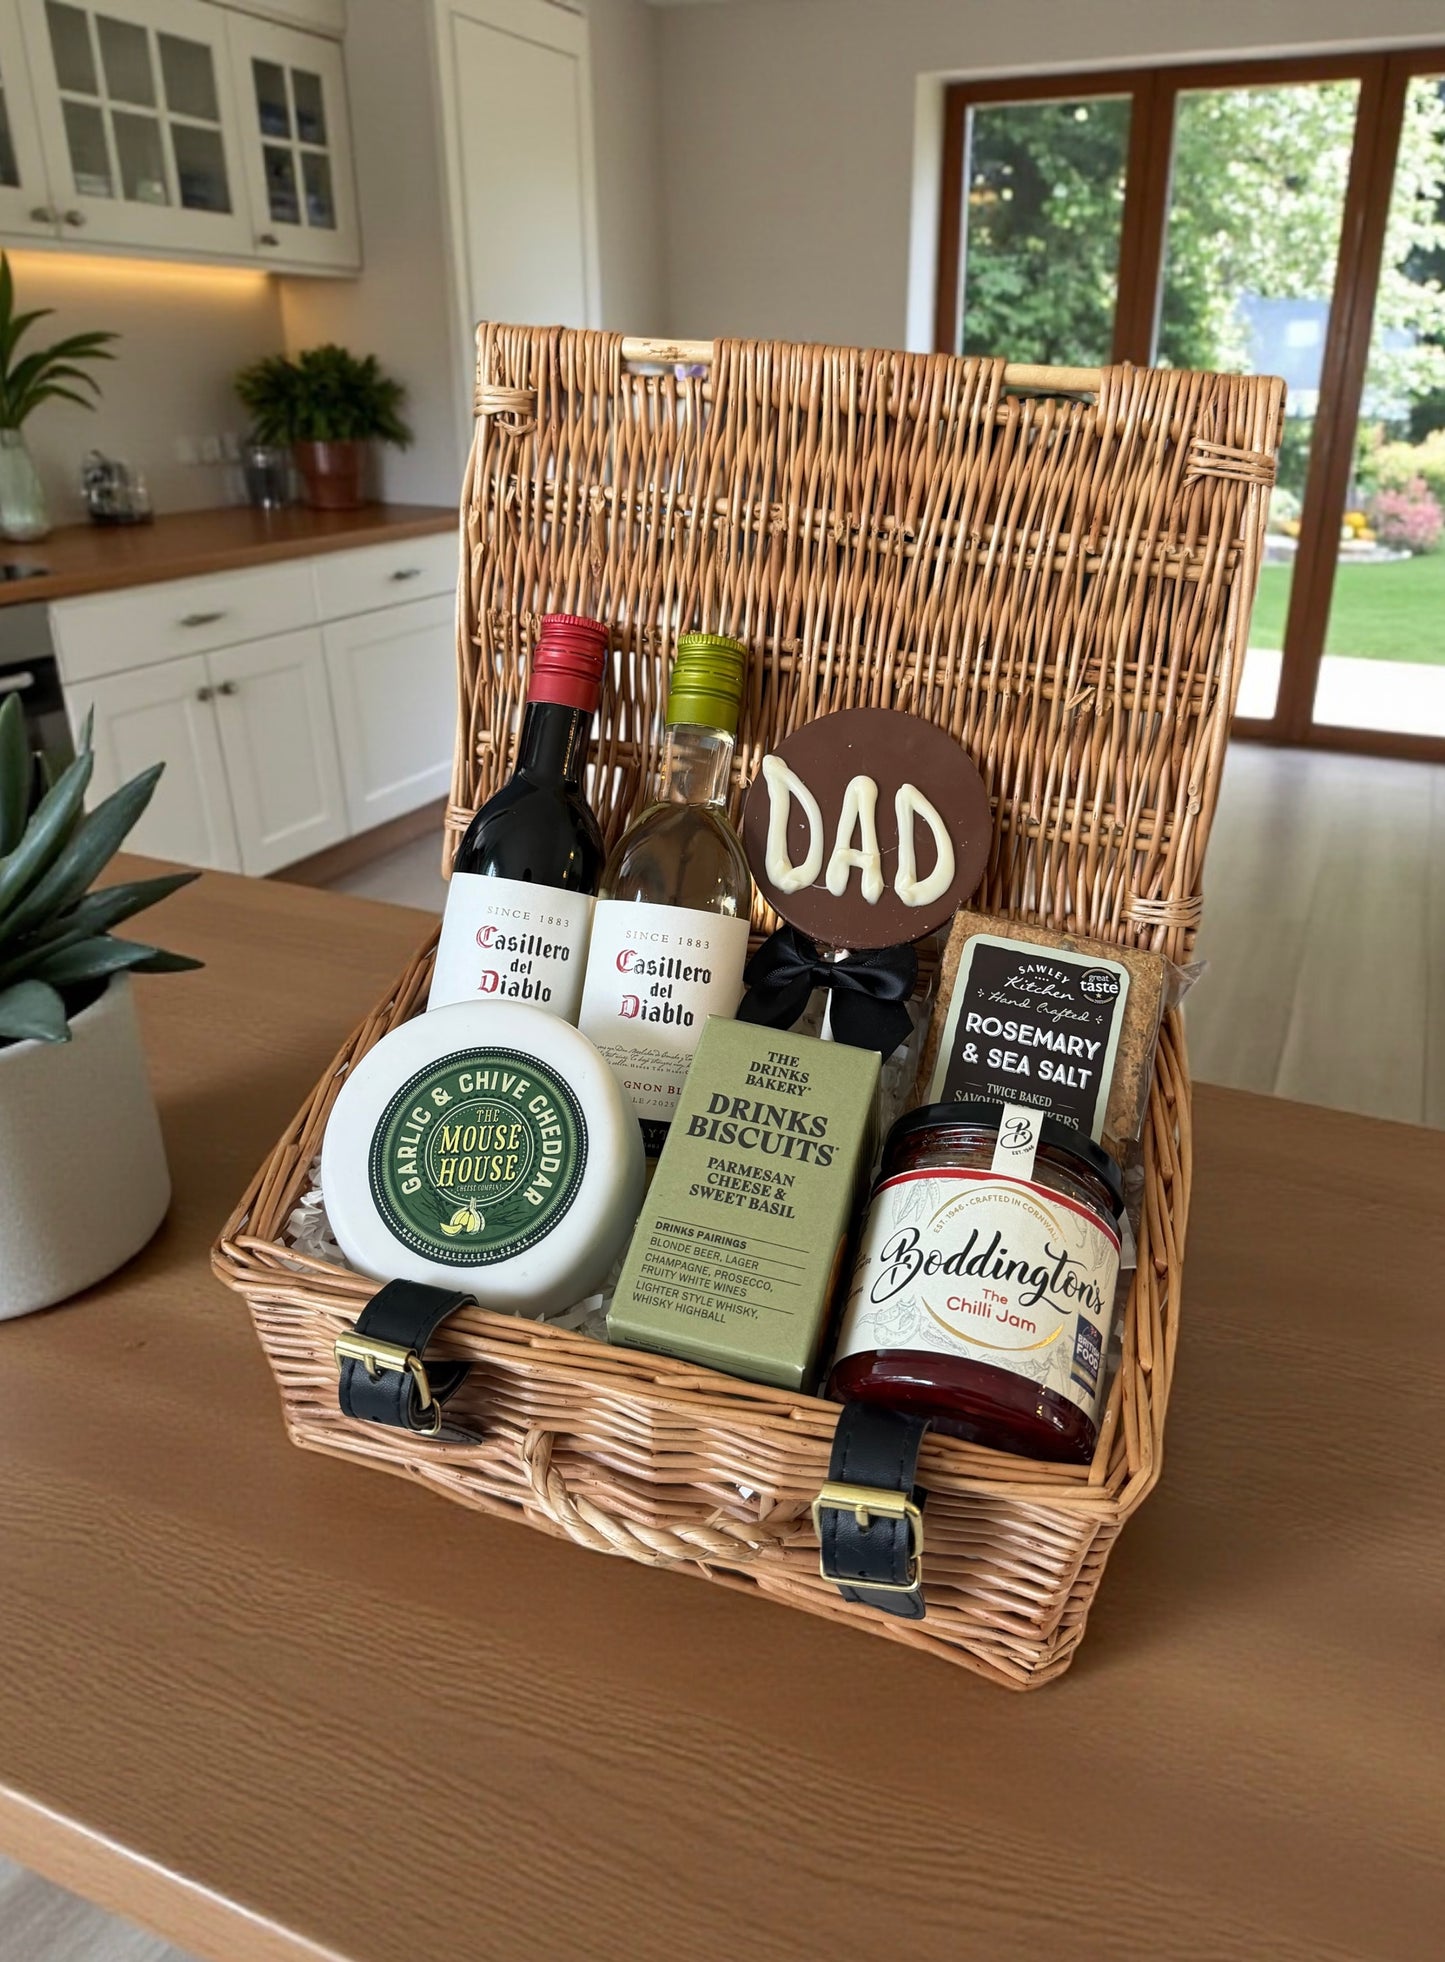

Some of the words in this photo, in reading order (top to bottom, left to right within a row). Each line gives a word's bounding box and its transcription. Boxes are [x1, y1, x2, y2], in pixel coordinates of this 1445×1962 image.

[762, 754, 955, 907] DAD
[487, 905, 531, 920] SINCE
[539, 914, 571, 928] 1883
[475, 925, 570, 962] Casillero
[625, 930, 669, 943] SINCE
[678, 936, 710, 950] 1883
[510, 958, 532, 975] del
[616, 949, 711, 984] Casillero
[1018, 964, 1071, 984] SAWLEY
[1088, 974, 1110, 983] great
[477, 969, 552, 1003] Diablo
[650, 982, 673, 999] del
[1003, 975, 1076, 1002] Kitchen
[1080, 980, 1119, 994] taste
[618, 994, 694, 1027] Diablo
[987, 990, 1031, 1010] Hand
[1036, 1002, 1090, 1023] Crafted
[964, 1011, 1101, 1061] ROSEMARY
[749, 1061, 810, 1084] DRINKS
[767, 1051, 800, 1068] THE
[962, 1042, 979, 1064] &
[986, 1048, 1031, 1077] SEA
[1037, 1059, 1093, 1090] SALT
[623, 1081, 662, 1093] GNON
[667, 1085, 682, 1096] BL
[745, 1073, 808, 1097] BAKERY
[986, 1082, 1018, 1100] TWICE
[1019, 1090, 1052, 1108] BAKED
[476, 1109, 500, 1124] THE
[632, 1097, 675, 1108] LE/2025
[706, 1092, 829, 1138] DRINKS
[397, 1106, 432, 1196] GARLIC
[431, 1087, 453, 1107] &
[458, 1070, 531, 1100] CHIVE
[522, 1094, 563, 1206] CHEDDAR
[437, 1123, 524, 1155] MOUSE
[686, 1114, 836, 1167] BISCUITS
[436, 1154, 519, 1188] HOUSE
[706, 1156, 796, 1187] PARMESAN
[706, 1172, 772, 1198] CHEESE
[773, 1187, 788, 1201] &
[689, 1183, 747, 1207] SWEET
[747, 1196, 796, 1219] BASIL
[933, 1219, 948, 1234] EST.
[946, 1203, 965, 1220] 1946
[969, 1194, 1010, 1206] CRAFTED
[1011, 1197, 1021, 1207] IN
[1022, 1202, 1060, 1243] CORNWALL
[655, 1221, 695, 1237] DRINKS
[696, 1230, 747, 1250] PAIRINGS
[650, 1236, 691, 1254] BLONDE
[693, 1247, 723, 1262] BEER,
[725, 1254, 759, 1270] LAGER
[640, 1264, 678, 1281] FRUITY
[678, 1274, 711, 1289] WHITE
[713, 1282, 747, 1298] WINES
[645, 1252, 711, 1277] CHAMPAGNE,
[714, 1269, 774, 1293] PROSECCO,
[870, 1226, 1106, 1316] Boddington's
[632, 1292, 673, 1310] WHISKY
[675, 1302, 726, 1324] HIGHBALL
[635, 1280, 679, 1299] LIGHTER
[681, 1290, 713, 1307] STYLE
[715, 1299, 760, 1320] WHISKY,
[982, 1288, 1008, 1306] The
[946, 1295, 992, 1319] Chilli
[995, 1309, 1037, 1334] Jam
[1076, 1343, 1099, 1371] FOOD
